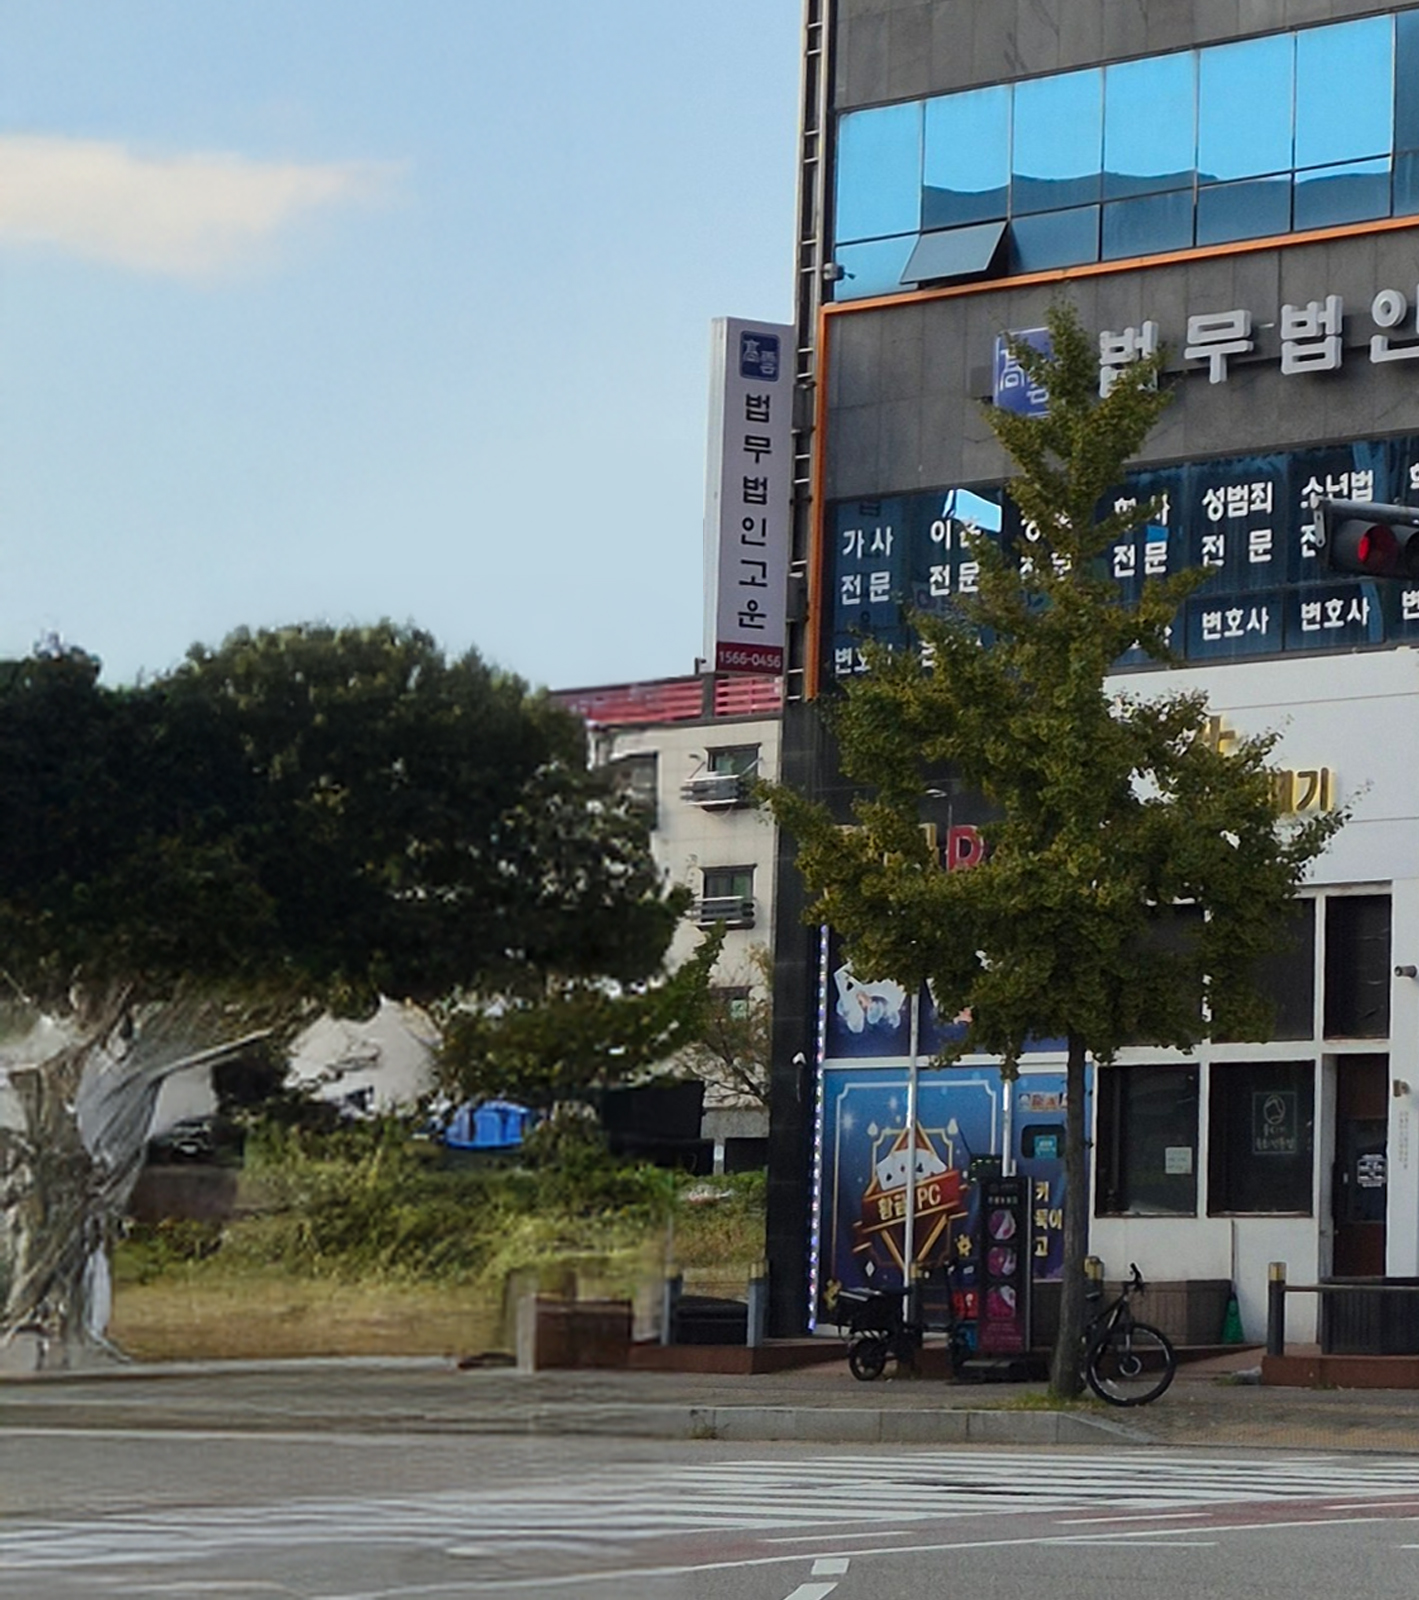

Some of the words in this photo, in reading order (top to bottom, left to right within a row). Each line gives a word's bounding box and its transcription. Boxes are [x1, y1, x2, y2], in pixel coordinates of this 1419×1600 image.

[1202, 481, 1274, 522] 성범죄
[1301, 469, 1374, 509] 소년법
[842, 525, 894, 558] 가사
[1113, 538, 1169, 578] 전문
[1201, 527, 1274, 567] 전문
[840, 570, 891, 605] 전문
[929, 563, 980, 597] 전문
[1202, 606, 1270, 641] 변호사
[1301, 595, 1371, 631] 변호사
[718, 650, 782, 669] 1566-0456
[917, 1184, 941, 1210] PC
